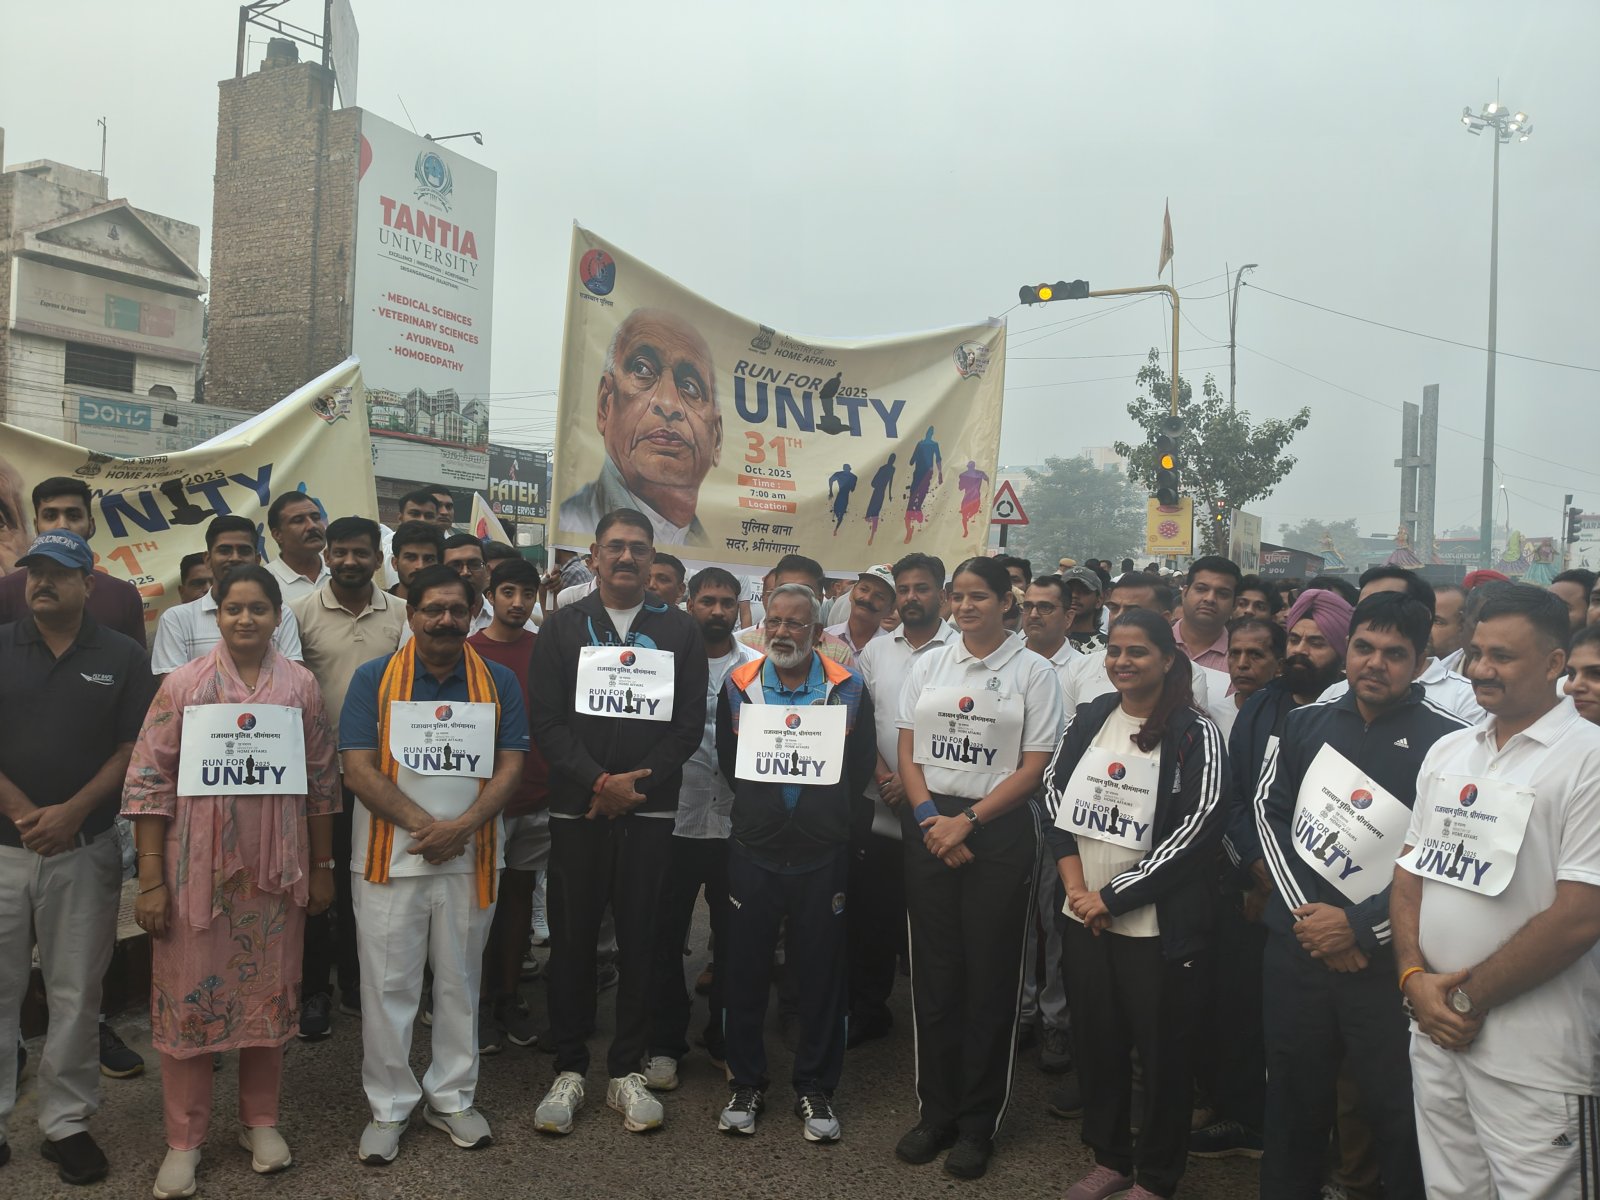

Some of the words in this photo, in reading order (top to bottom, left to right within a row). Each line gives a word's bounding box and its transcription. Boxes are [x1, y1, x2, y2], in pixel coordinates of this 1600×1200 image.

[380, 195, 478, 260] TANTIA
[378, 228, 478, 276] UNIVERSITY
[388, 292, 430, 313] MEDICAL
[432, 306, 472, 326] SCIENCES
[378, 307, 438, 331] VETERINARY
[440, 324, 479, 344] SCIENCES
[406, 332, 454, 354] AYURVEDA
[394, 346, 464, 372] HOMOEOPATHY
[774, 348, 802, 360] HOME
[802, 355, 838, 368] AFFAIRS
[734, 360, 781, 384] RUN
[783, 372, 822, 392] FOR
[838, 386, 868, 398] 2025
[83, 402, 148, 426] DOMS
[106, 471, 142, 480] HOME
[745, 465, 766, 476] Oct.
[768, 468, 792, 478] 2025
[490, 478, 538, 504] FATEH
[750, 489, 768, 498] 7:00
[752, 478, 776, 488] Time
[100, 463, 273, 538] NITY
[748, 500, 788, 511] Location
[742, 519, 770, 536] पुलिस
[772, 524, 793, 536] थाना
[726, 538, 748, 552] सदर,
[752, 538, 800, 554] श्रीगंगानगर
[1264, 552, 1290, 564] पुलिस
[932, 734, 947, 742] RUN
[950, 736, 962, 744] FOR
[1075, 799, 1090, 809] RUN
[1092, 803, 1110, 814] FOR
[1301, 807, 1312, 823] RUN
[1313, 819, 1330, 836] FOR
[1335, 841, 1350, 856] 2025
[1330, 818, 1341, 830] HOME
[1341, 827, 1357, 842] AFFAIRS
[1440, 841, 1456, 852] FOR
[1464, 850, 1476, 858] 2025
